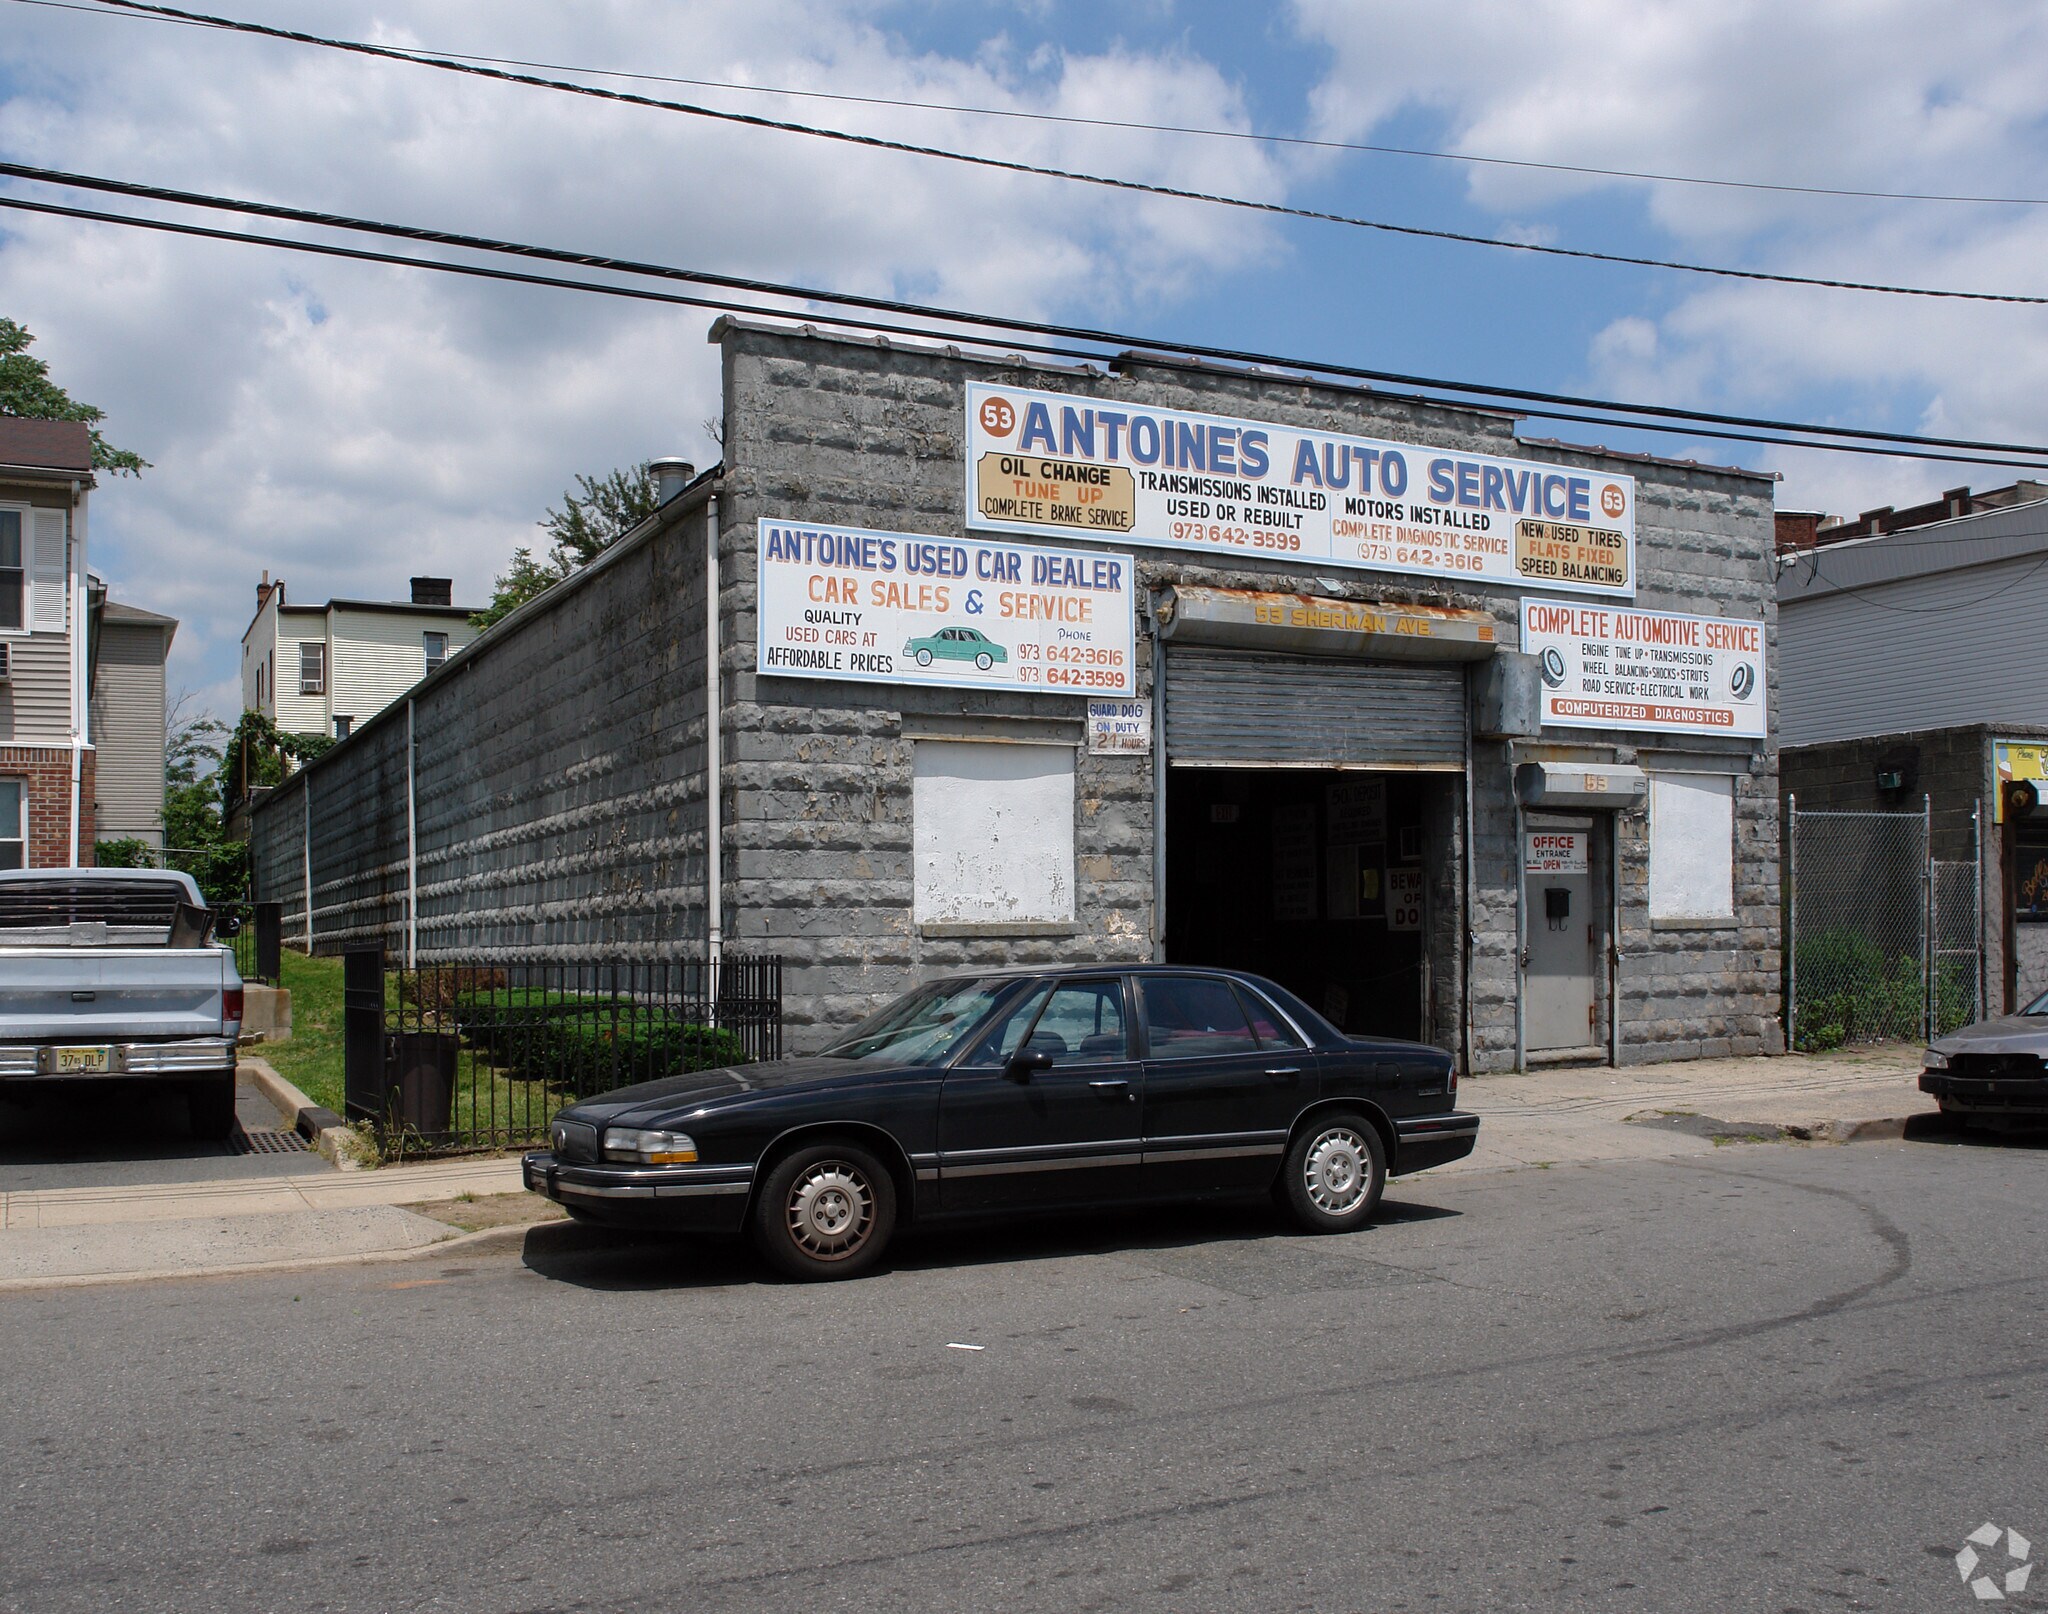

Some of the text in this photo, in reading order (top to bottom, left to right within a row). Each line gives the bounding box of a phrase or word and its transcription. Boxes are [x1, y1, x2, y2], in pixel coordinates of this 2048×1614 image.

[984, 402, 1623, 522] 53 ANTOINE'S AUTO SERVICE 53
[1000, 457, 1111, 486] OIL CHANGE
[1013, 479, 1103, 504] TUNE UP
[1139, 471, 1326, 512] TRANSMISSIONS INSTALLED
[985, 497, 1129, 527] COMPLETE BRAKE SERVICE
[1167, 499, 1303, 529] USED OR REBUILT
[1345, 497, 1490, 531] MOTORS INSTALLED
[1332, 518, 1508, 555] COMPLETE DIAGNOSTIC SERVICE
[1588, 530, 1622, 548] TIRES
[766, 528, 1122, 593] ANTOINE'S USED CAR DEALER
[1357, 543, 1392, 562] (973)
[1529, 540, 1614, 565] FLATS FIXED
[1521, 558, 1622, 583] SPEED BALANCING
[808, 575, 1093, 624] CAR SALES & SERVICE
[804, 609, 863, 627] QUALITY
[1255, 606, 1284, 624] 53
[1291, 608, 1386, 633] SHERMAN
[1527, 605, 1609, 638] COMPLETE
[1614, 614, 1700, 647] AUTOMOTIVE
[1705, 623, 1759, 653] SERVICE
[785, 627, 878, 648] USED CARS AT
[767, 647, 894, 674] AFFORDABLE PRICES
[1582, 643, 1609, 658] ENGINE
[1615, 646, 1631, 659] TUNE
[1650, 649, 1713, 666] TRANSMISSIONS
[1582, 661, 1609, 675] WHEEL
[1615, 663, 1649, 678] BALANCING
[1680, 669, 1709, 682] STRUTS
[1582, 678, 1601, 693] ROAD
[1689, 687, 1710, 700] WORK
[1090, 703, 1143, 718] GUARD DOG
[1557, 700, 1730, 723] COMPUTERIZED DIAGNOSTICS
[1096, 722, 1140, 733] ON DUTY
[1121, 738, 1146, 749] HOURS
[1533, 836, 1574, 849] OFFICE
[1536, 850, 1571, 858] ENTRANCE
[1543, 860, 1561, 870] OPEN
[1390, 873, 1421, 891] BEWA
[1403, 894, 1421, 904] OF
[1395, 909, 1419, 925] DO
